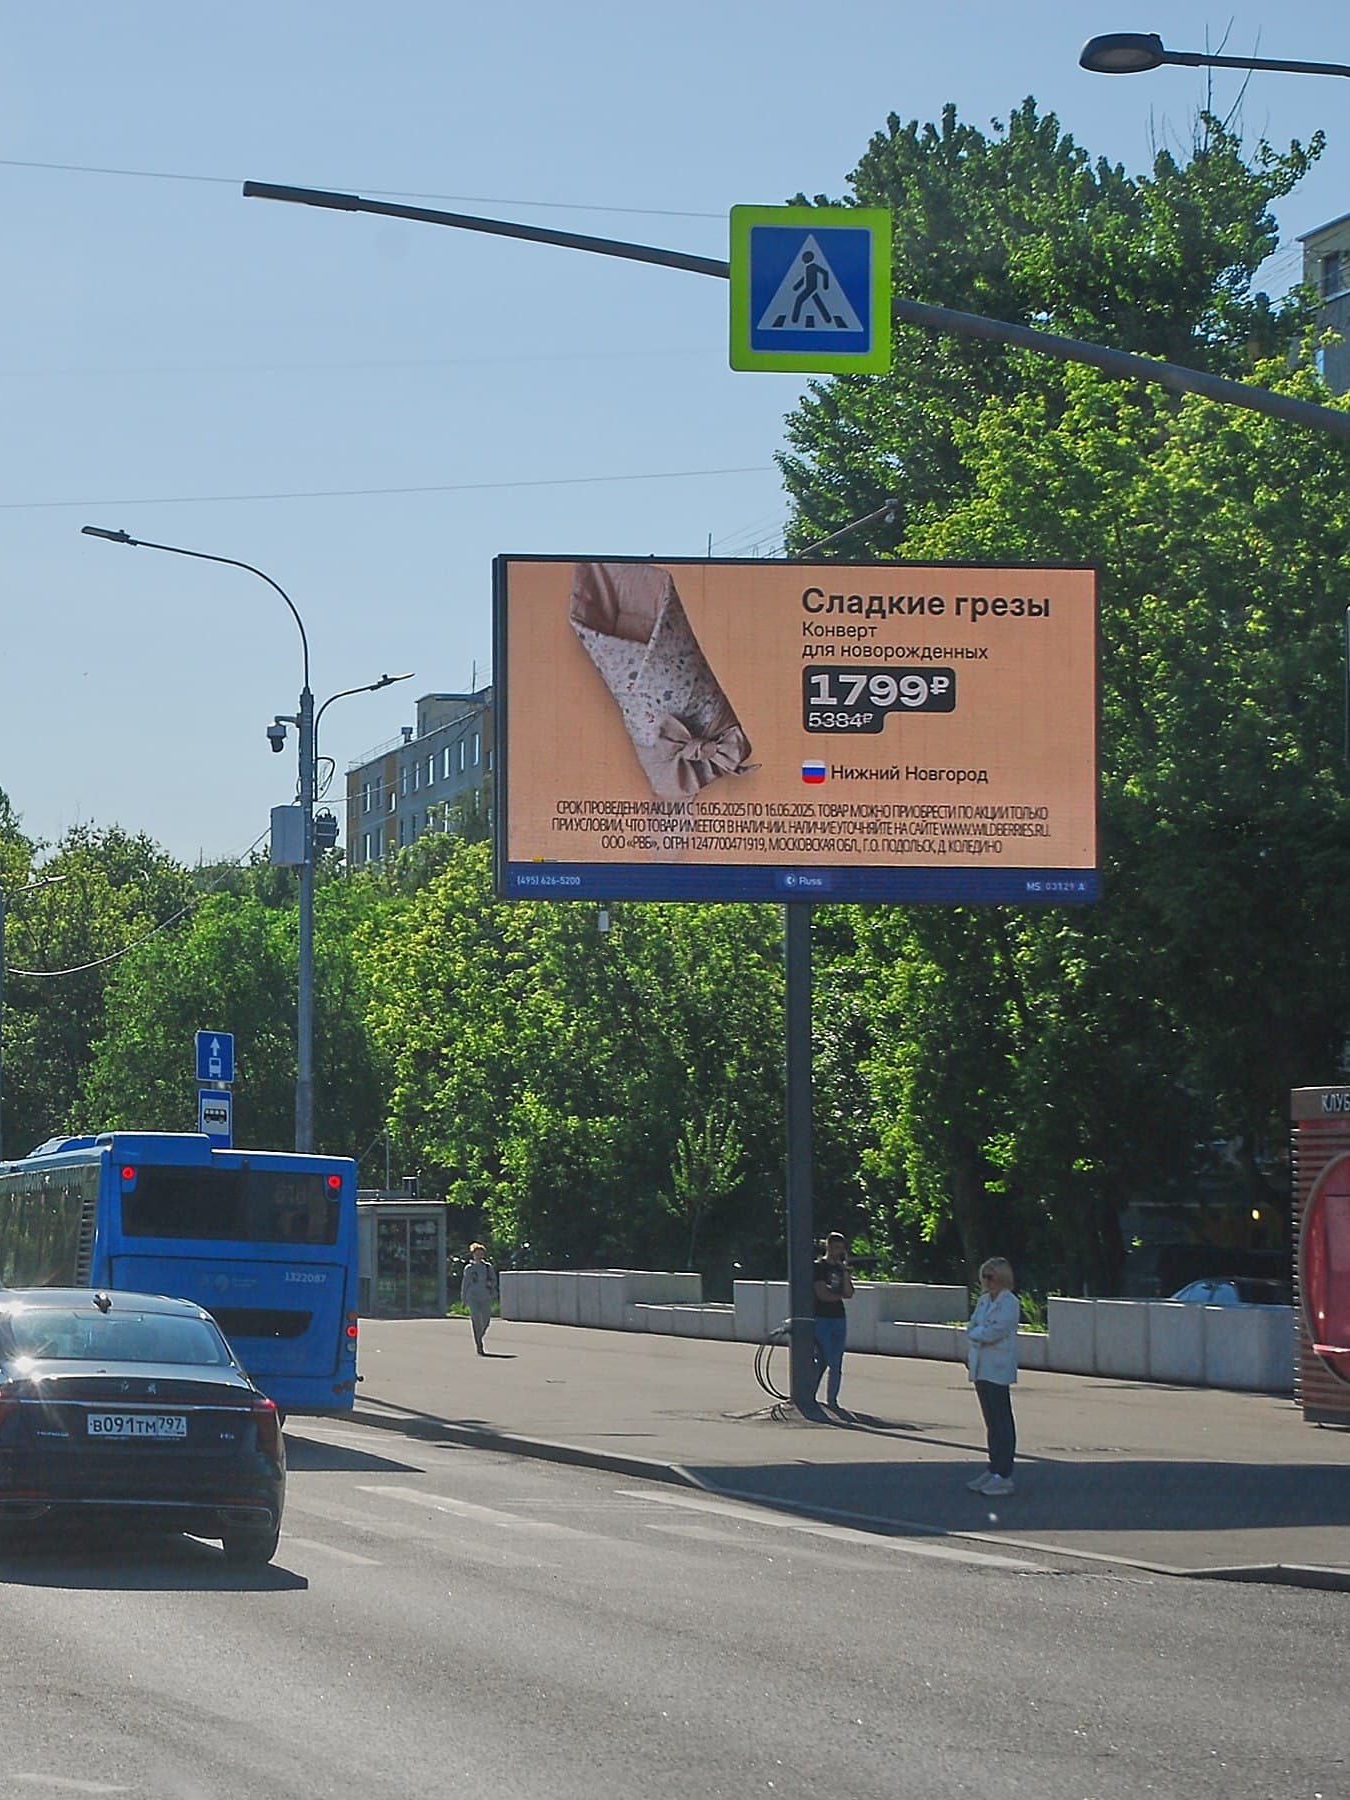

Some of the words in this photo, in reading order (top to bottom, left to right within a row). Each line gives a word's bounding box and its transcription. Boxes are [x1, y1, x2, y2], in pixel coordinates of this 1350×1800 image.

[802, 587, 945, 619] Сладкие
[955, 597, 1050, 622] грезы
[802, 621, 877, 641] Конверт
[802, 645, 835, 659] для
[841, 646, 988, 661] новорожденных
[831, 765, 899, 780] Нижний
[905, 766, 988, 784] Новгород
[557, 801, 583, 814] СРОК
[584, 801, 650, 817] ПРОВЕДЕНИЯ
[651, 802, 685, 817] АКЦИИ
[687, 802, 694, 816] С
[696, 802, 745, 816] 16.05.2025
[747, 803, 763, 816] ПО
[818, 803, 849, 817] ТОВАР
[850, 804, 891, 818] МОЖНО
[893, 805, 956, 819] ПРИОБРЕСТИ
[958, 805, 972, 819] ПО
[974, 805, 1008, 821] АКЦИИ
[1010, 806, 1048, 820] ТОЛЬКО
[552, 818, 574, 831] ПРИ
[574, 818, 624, 833] УСЛОВИИ,
[625, 818, 645, 832] ЧТО
[647, 819, 678, 832] ТОВАР
[680, 819, 725, 833] ИМЕЕТСЯ
[727, 820, 734, 833] В
[789, 820, 836, 834] НАЛИЧИЕ
[837, 819, 892, 835] УТОЧНЯЙТЕ
[894, 822, 907, 835] НА
[909, 820, 939, 835] САЙТЕ
[602, 835, 625, 849] ООО
[663, 836, 689, 849] ОГРН
[768, 837, 835, 850] МОСКОВСКАЯ
[949, 840, 1002, 855] КОЛЕДИНО
